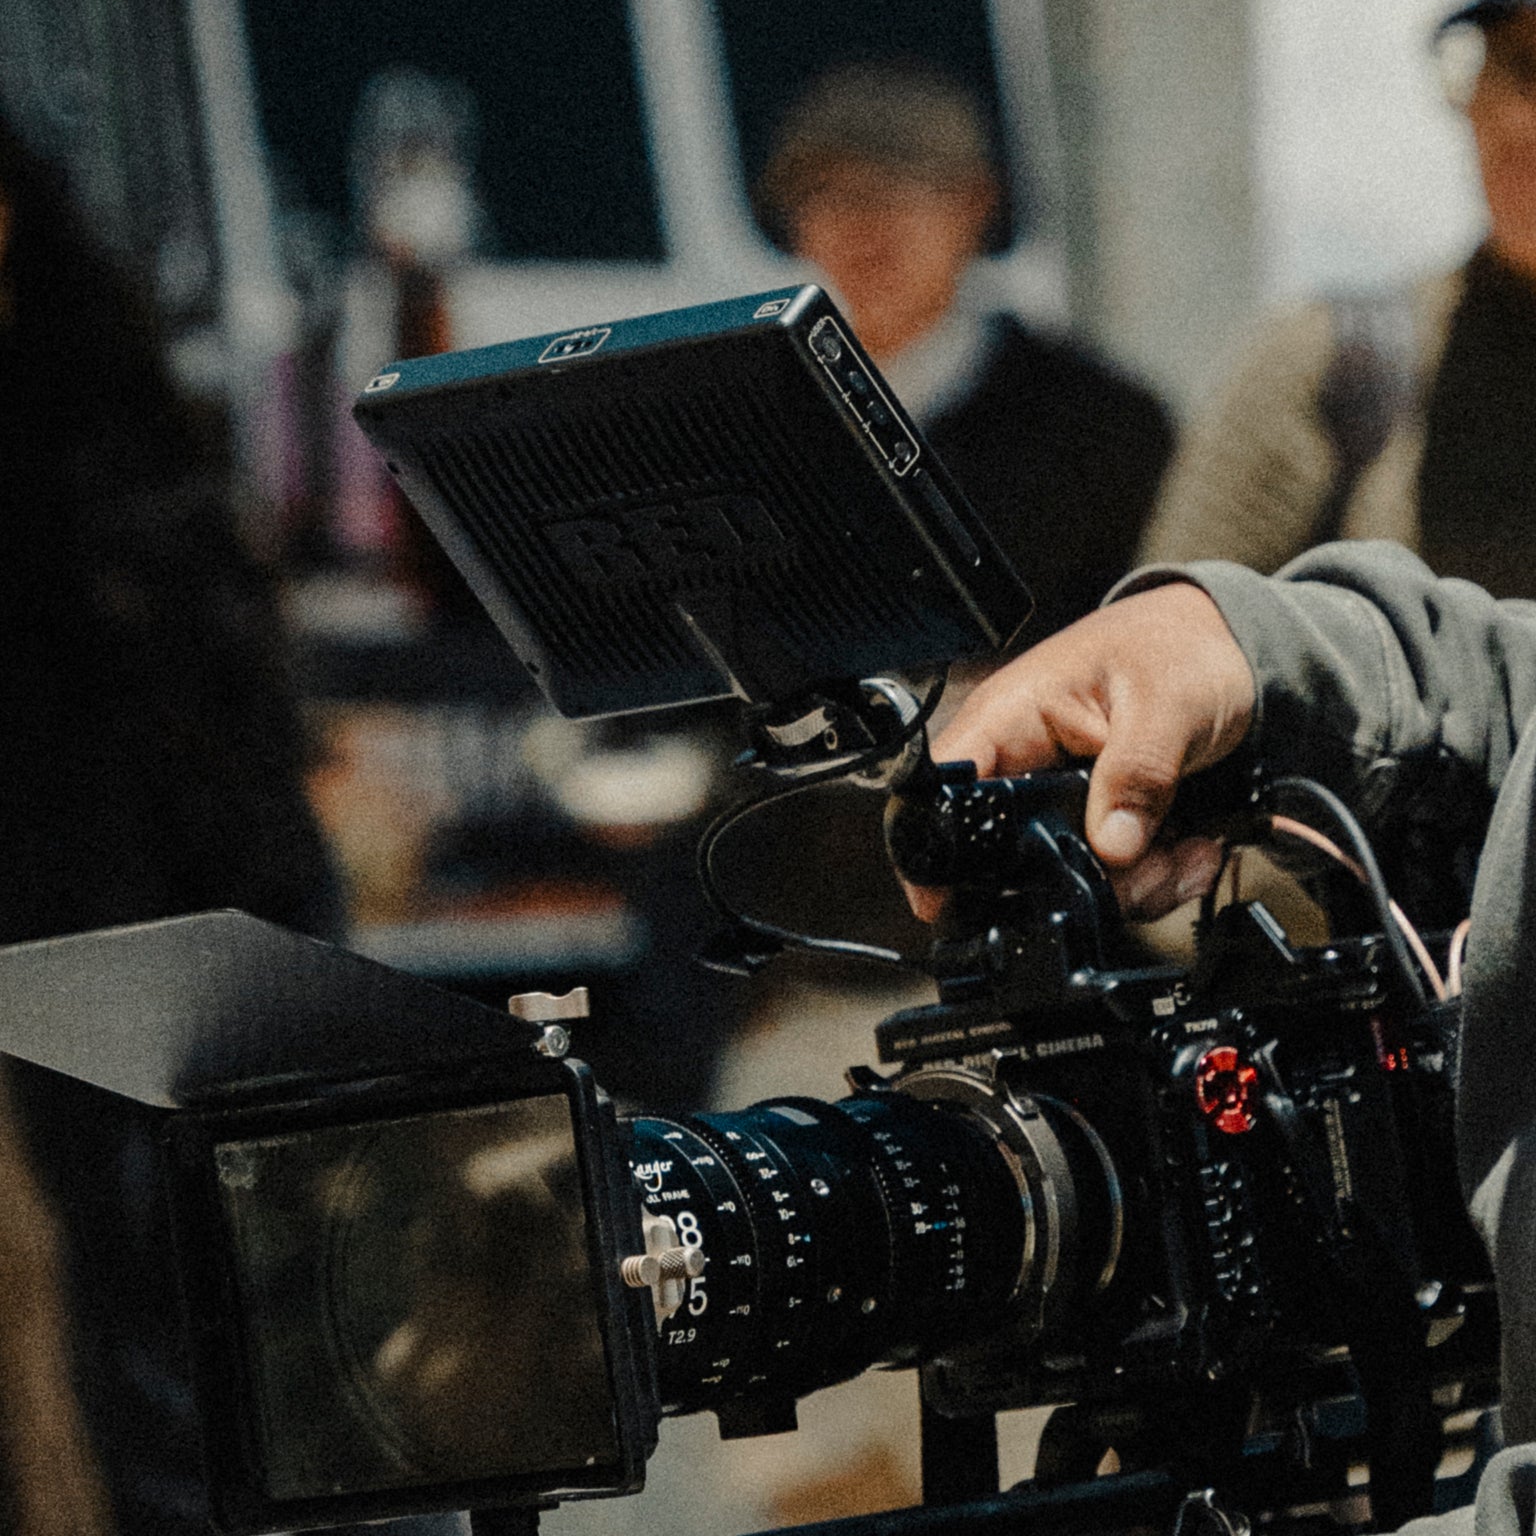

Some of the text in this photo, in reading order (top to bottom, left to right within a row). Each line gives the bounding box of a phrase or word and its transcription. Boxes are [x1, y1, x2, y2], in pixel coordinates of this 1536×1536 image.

[544, 495, 787, 577] RED
[628, 1160, 673, 1192] anger
[668, 1328, 697, 1345] T2.9
